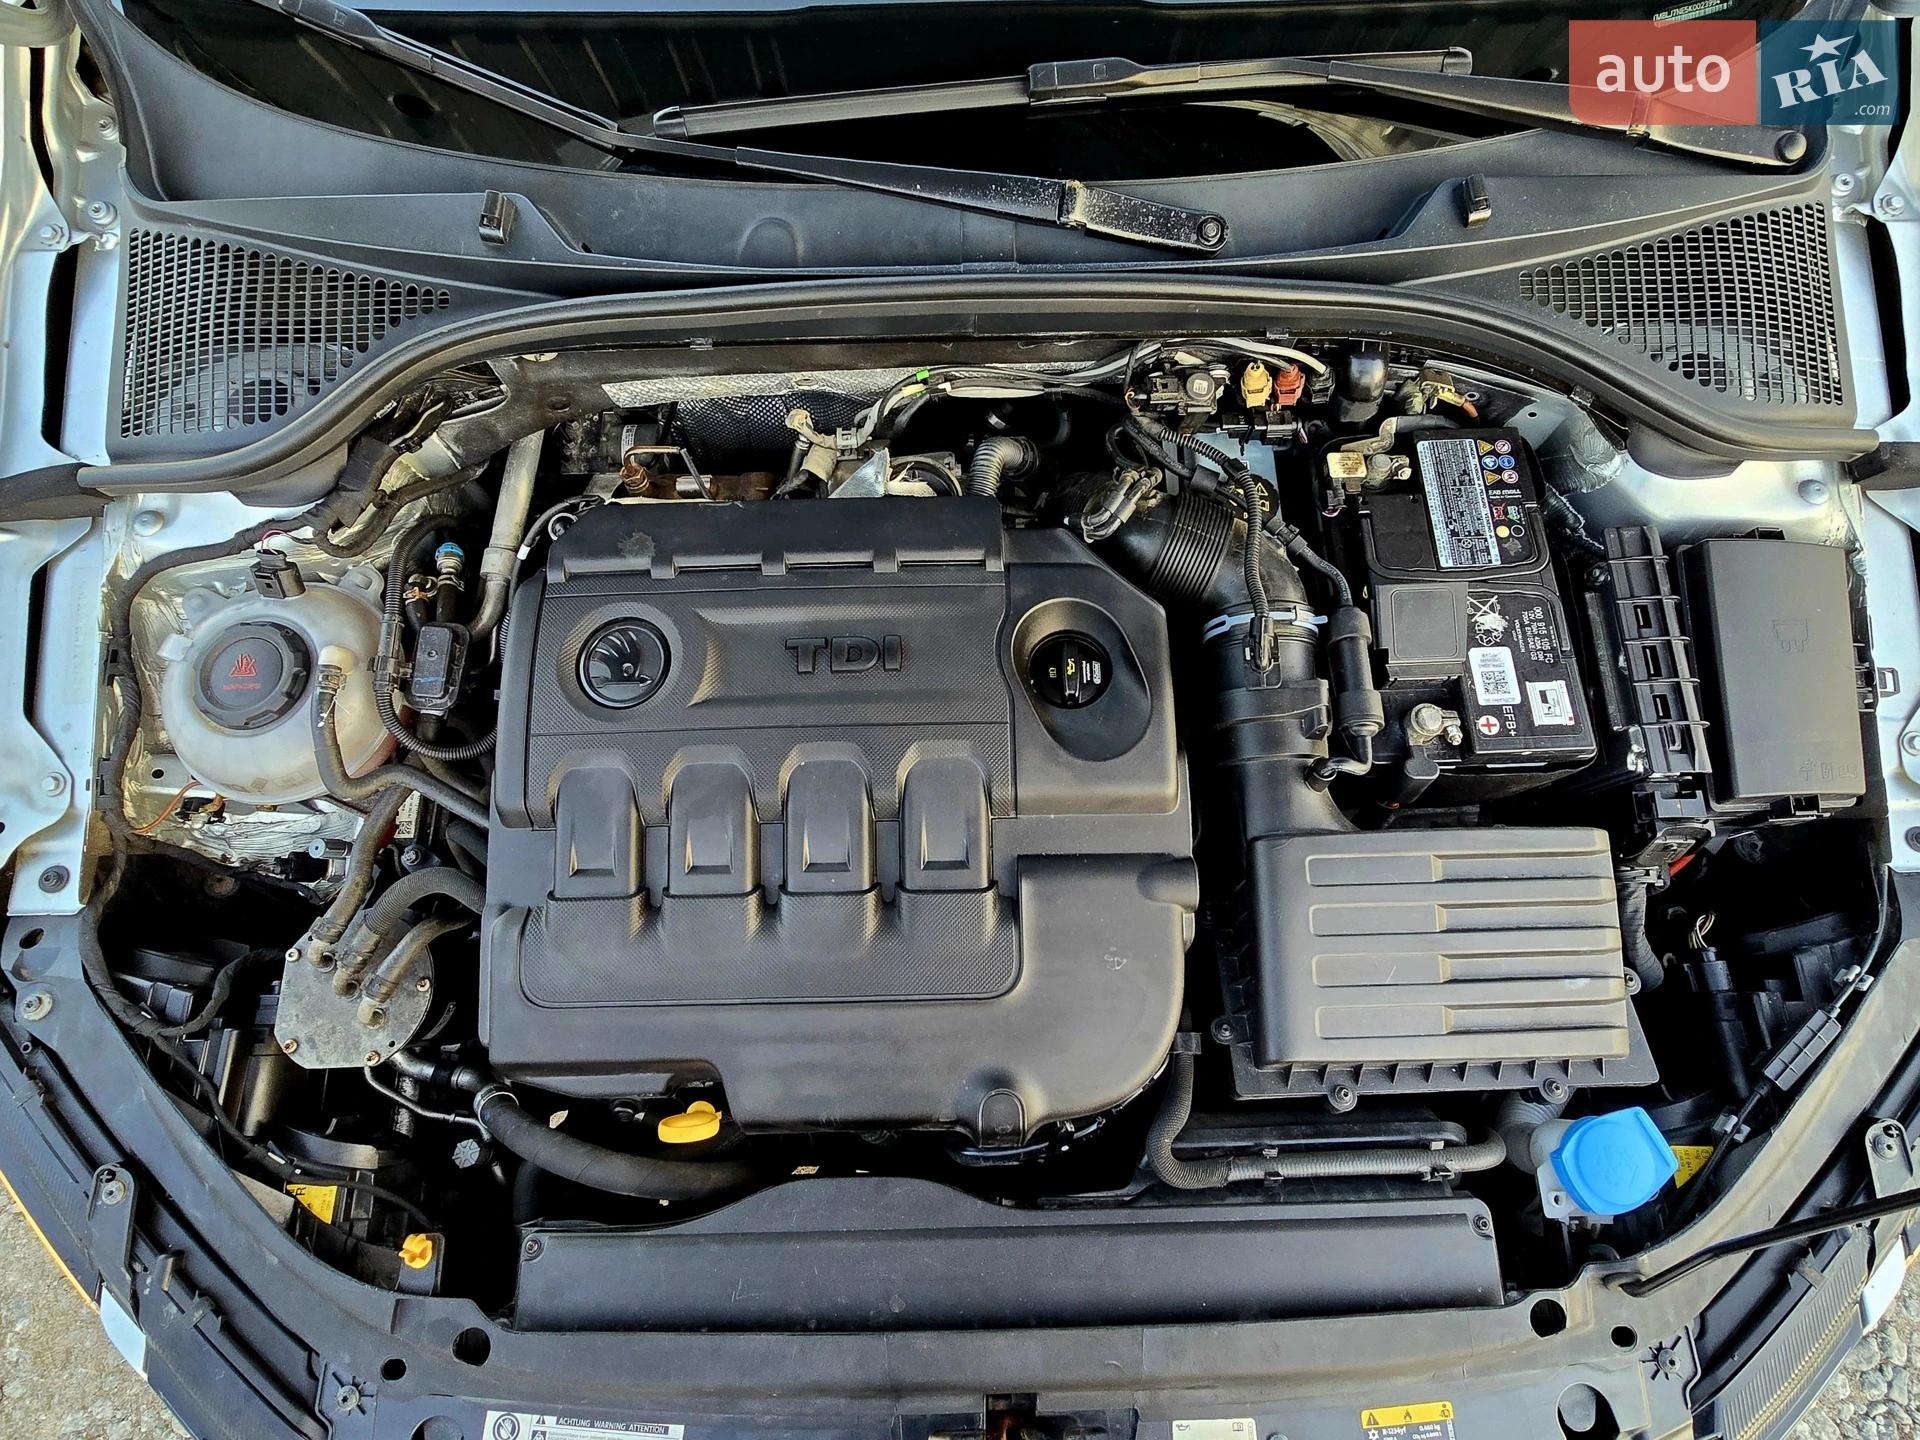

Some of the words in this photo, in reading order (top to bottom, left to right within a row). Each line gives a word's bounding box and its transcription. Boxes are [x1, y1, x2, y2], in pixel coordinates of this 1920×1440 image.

[1514, 618, 1526, 653] VOLKSWAGEN
[785, 634, 903, 674] TDI
[1502, 705, 1517, 737] EFB+
[558, 1417, 591, 1427] ACHTUNG
[593, 1420, 626, 1431] WARNING
[628, 1423, 665, 1434] ATTENTION
